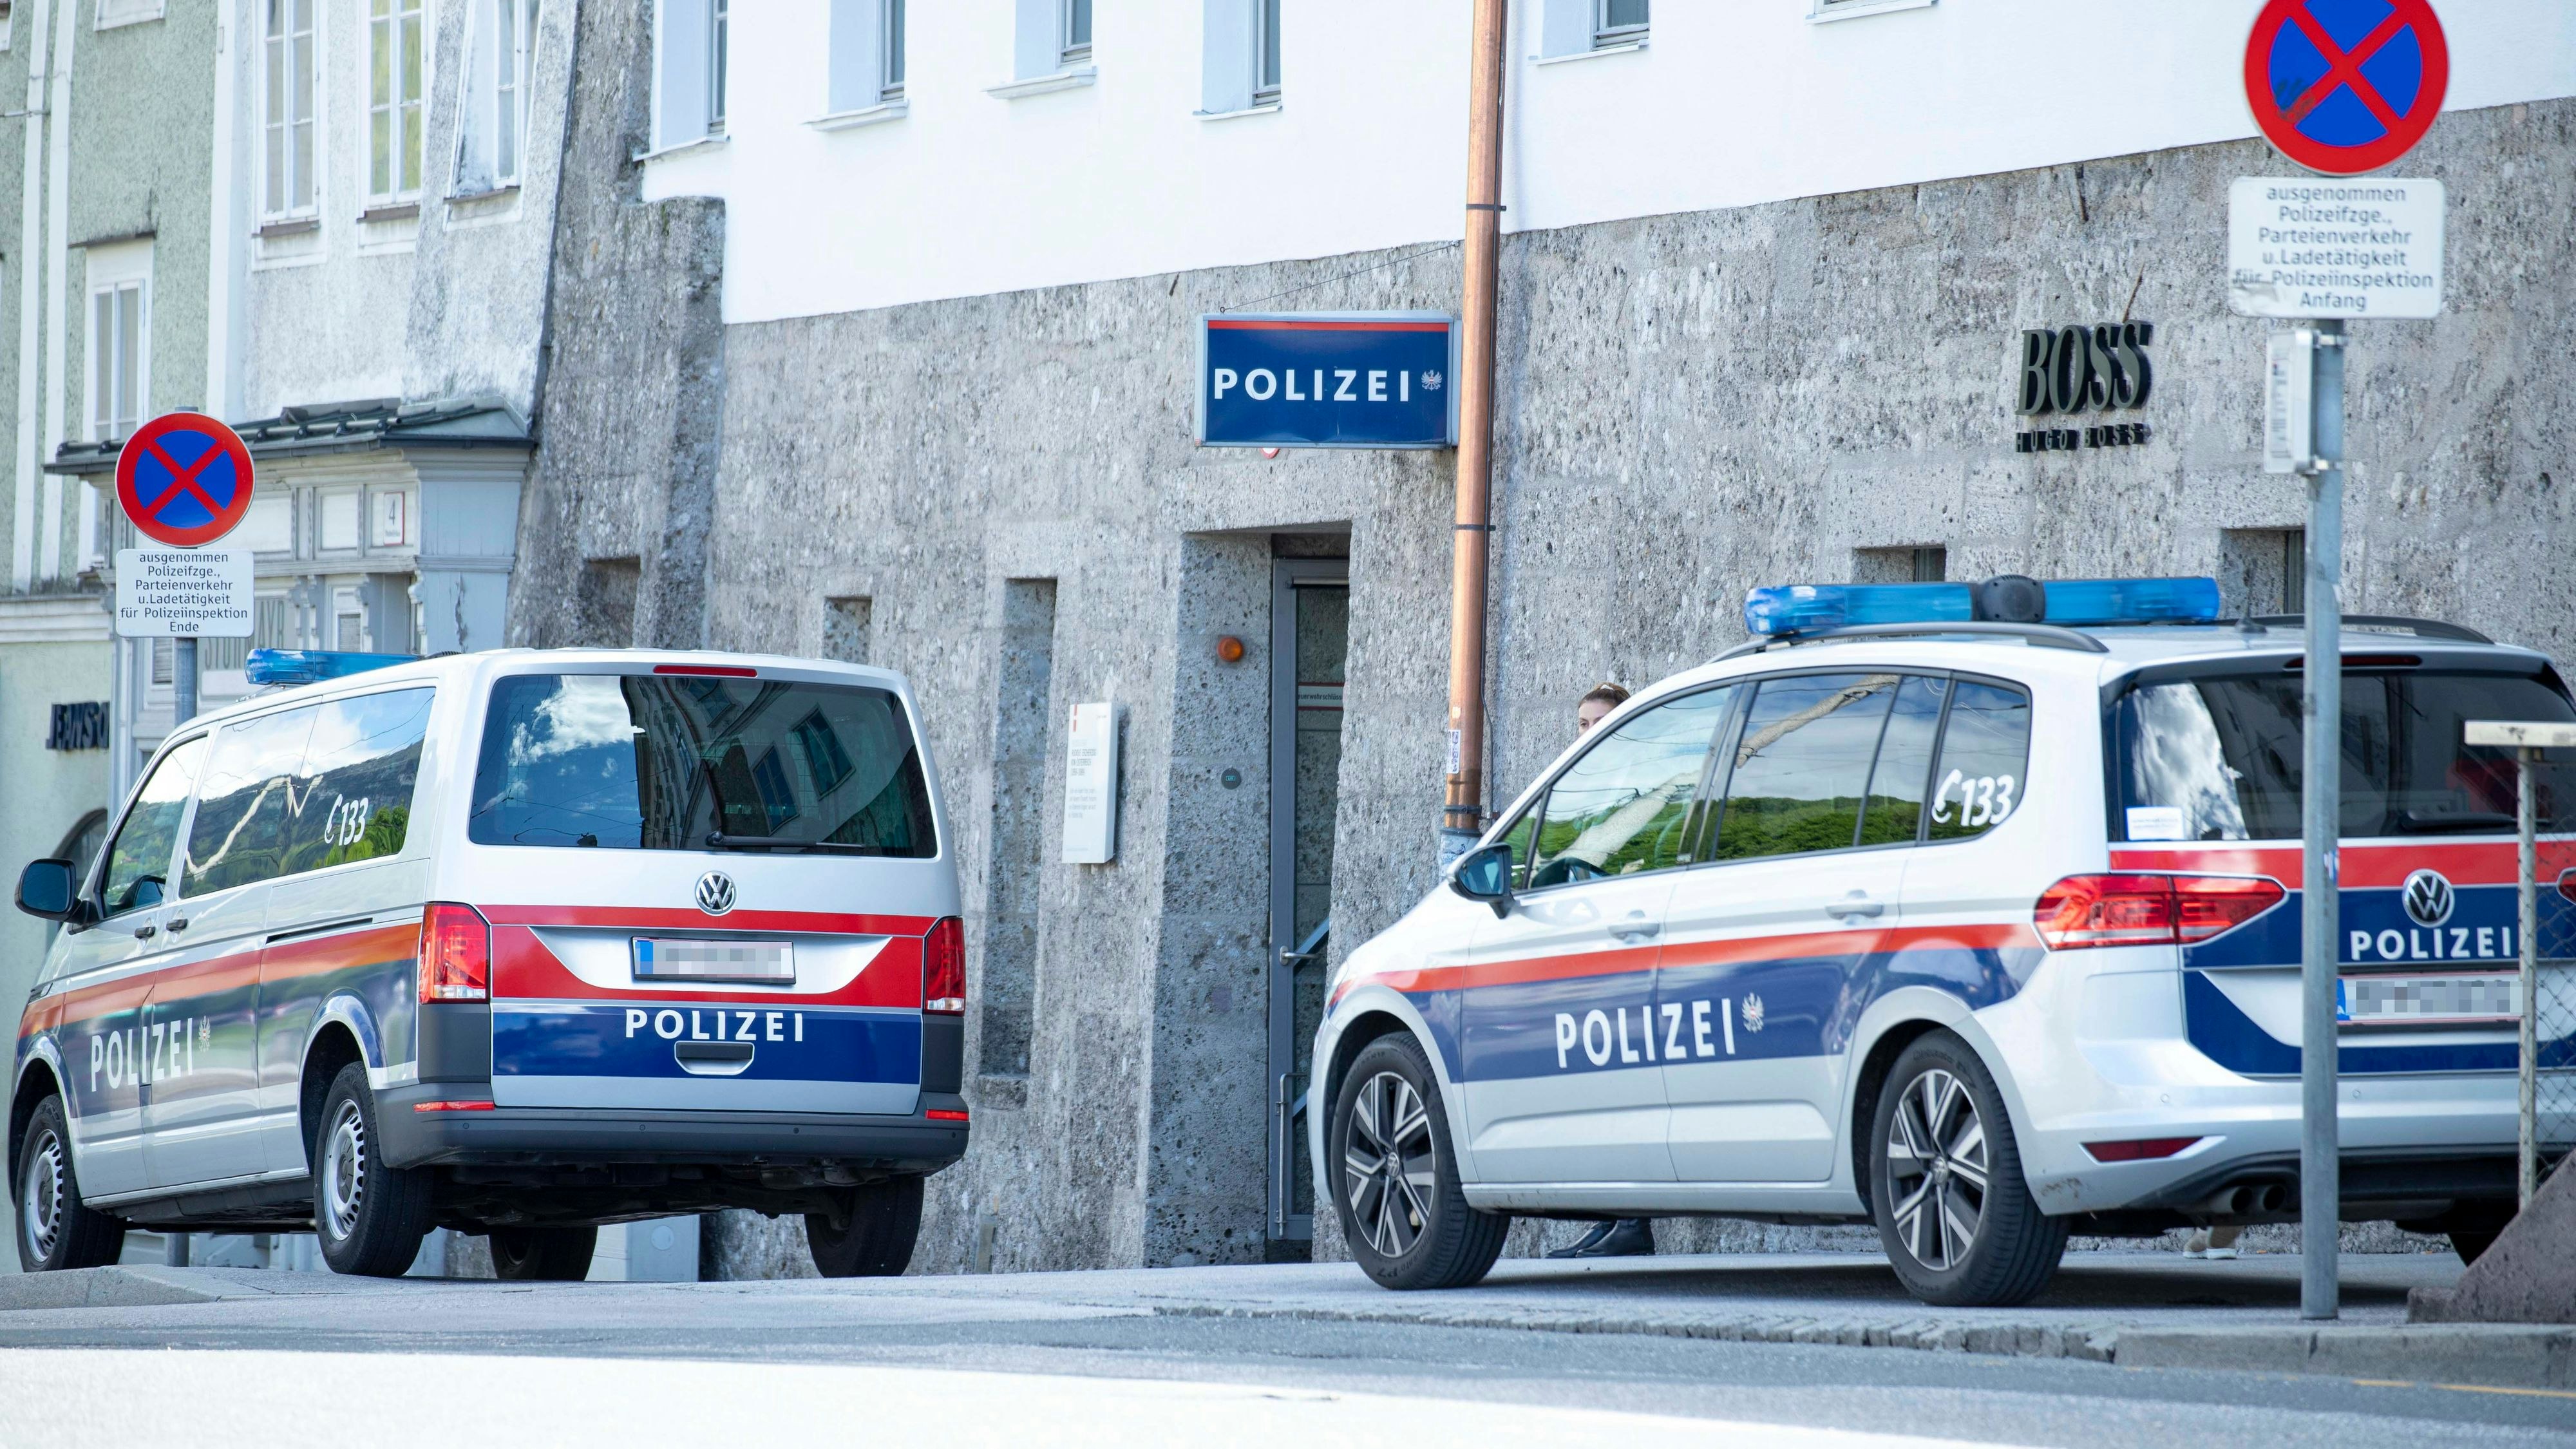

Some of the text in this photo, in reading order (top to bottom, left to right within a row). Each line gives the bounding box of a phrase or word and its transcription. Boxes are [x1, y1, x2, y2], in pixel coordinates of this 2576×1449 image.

[2266, 187, 2406, 204] ausgenommen
[2258, 227, 2411, 244] Parteienverkehr
[2271, 270, 2434, 290] Polizeiinspektion
[2299, 292, 2367, 312] Anfang
[2015, 319, 2152, 415] BOSS
[1214, 368, 1409, 402] POLIZEI
[2016, 423, 2146, 453] HUGO BOSS
[388, 499, 395, 526] 4
[139, 554, 229, 565] ausgenommen
[147, 565, 220, 578] Polizeifzge.,
[135, 580, 233, 591] Parteienverkehr
[120, 607, 248, 620] für Polizeiinspektion
[169, 621, 200, 632] Ende
[1960, 774, 2015, 827] 133
[338, 797, 369, 846] 133
[2350, 925, 2512, 961] POLIZEI
[625, 1009, 803, 1042] POLIZEI
[1555, 998, 1736, 1069] POLIZEI
[91, 1018, 193, 1092] POLIZEI
